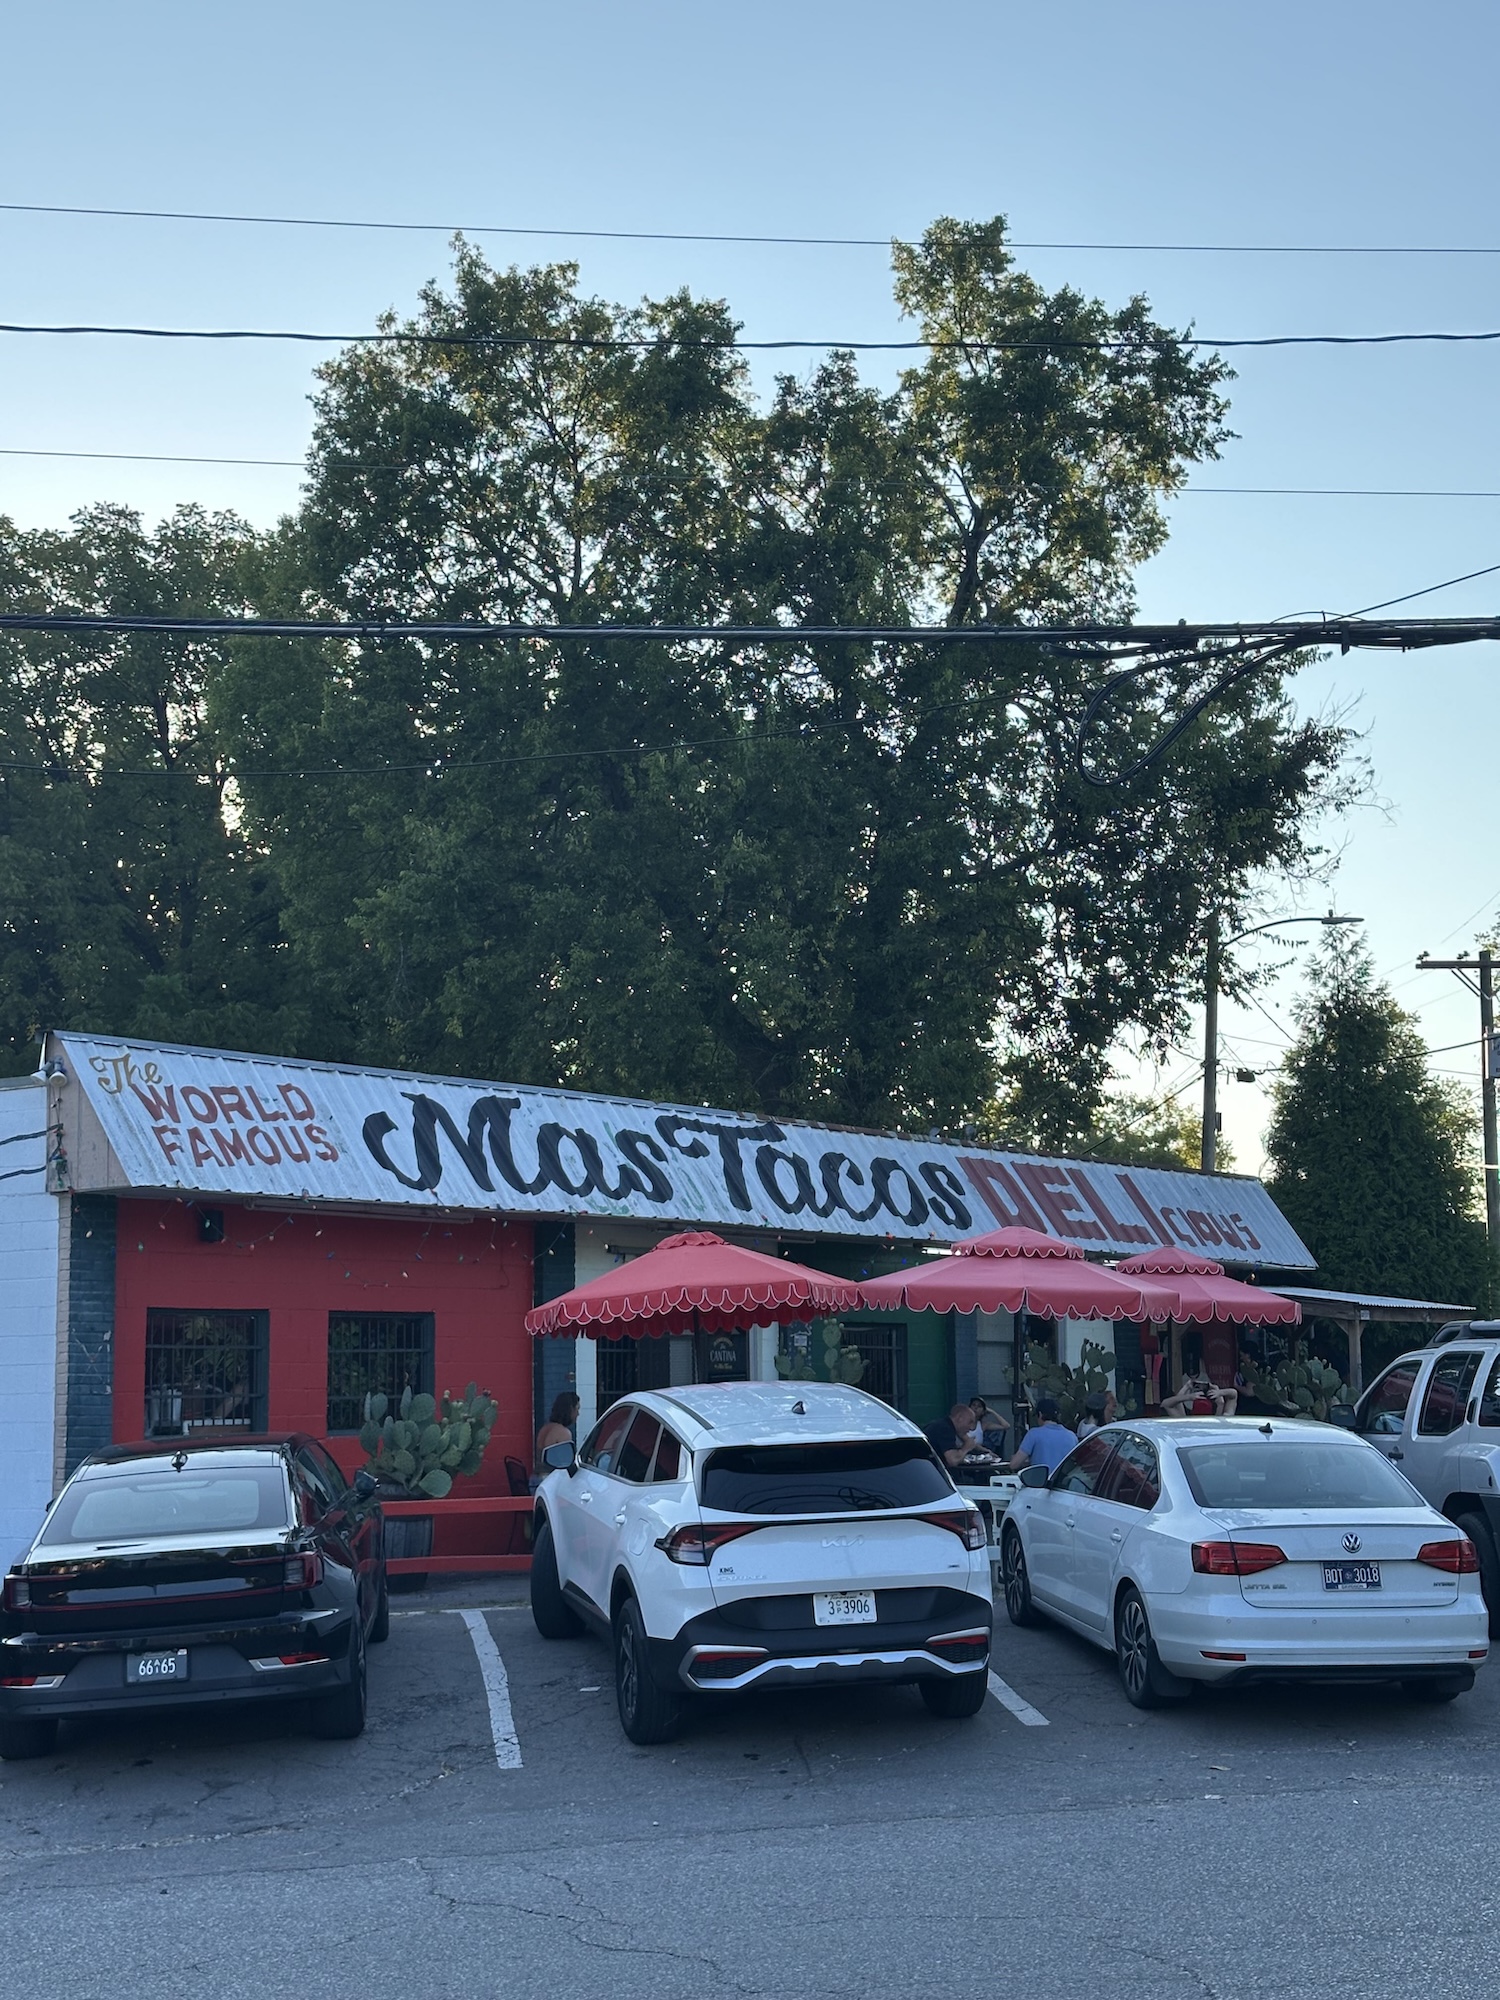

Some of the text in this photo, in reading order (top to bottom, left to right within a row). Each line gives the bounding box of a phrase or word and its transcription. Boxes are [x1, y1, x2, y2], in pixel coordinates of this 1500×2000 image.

[89, 1053, 163, 1094] The
[130, 1083, 316, 1124] WORLD
[152, 1123, 340, 1168] FAMOUS
[362, 1091, 674, 1204] Mas
[655, 1114, 973, 1230] Tacos
[709, 1349, 737, 1362] CANTINA
[1353, 1567, 1379, 1582] 3018
